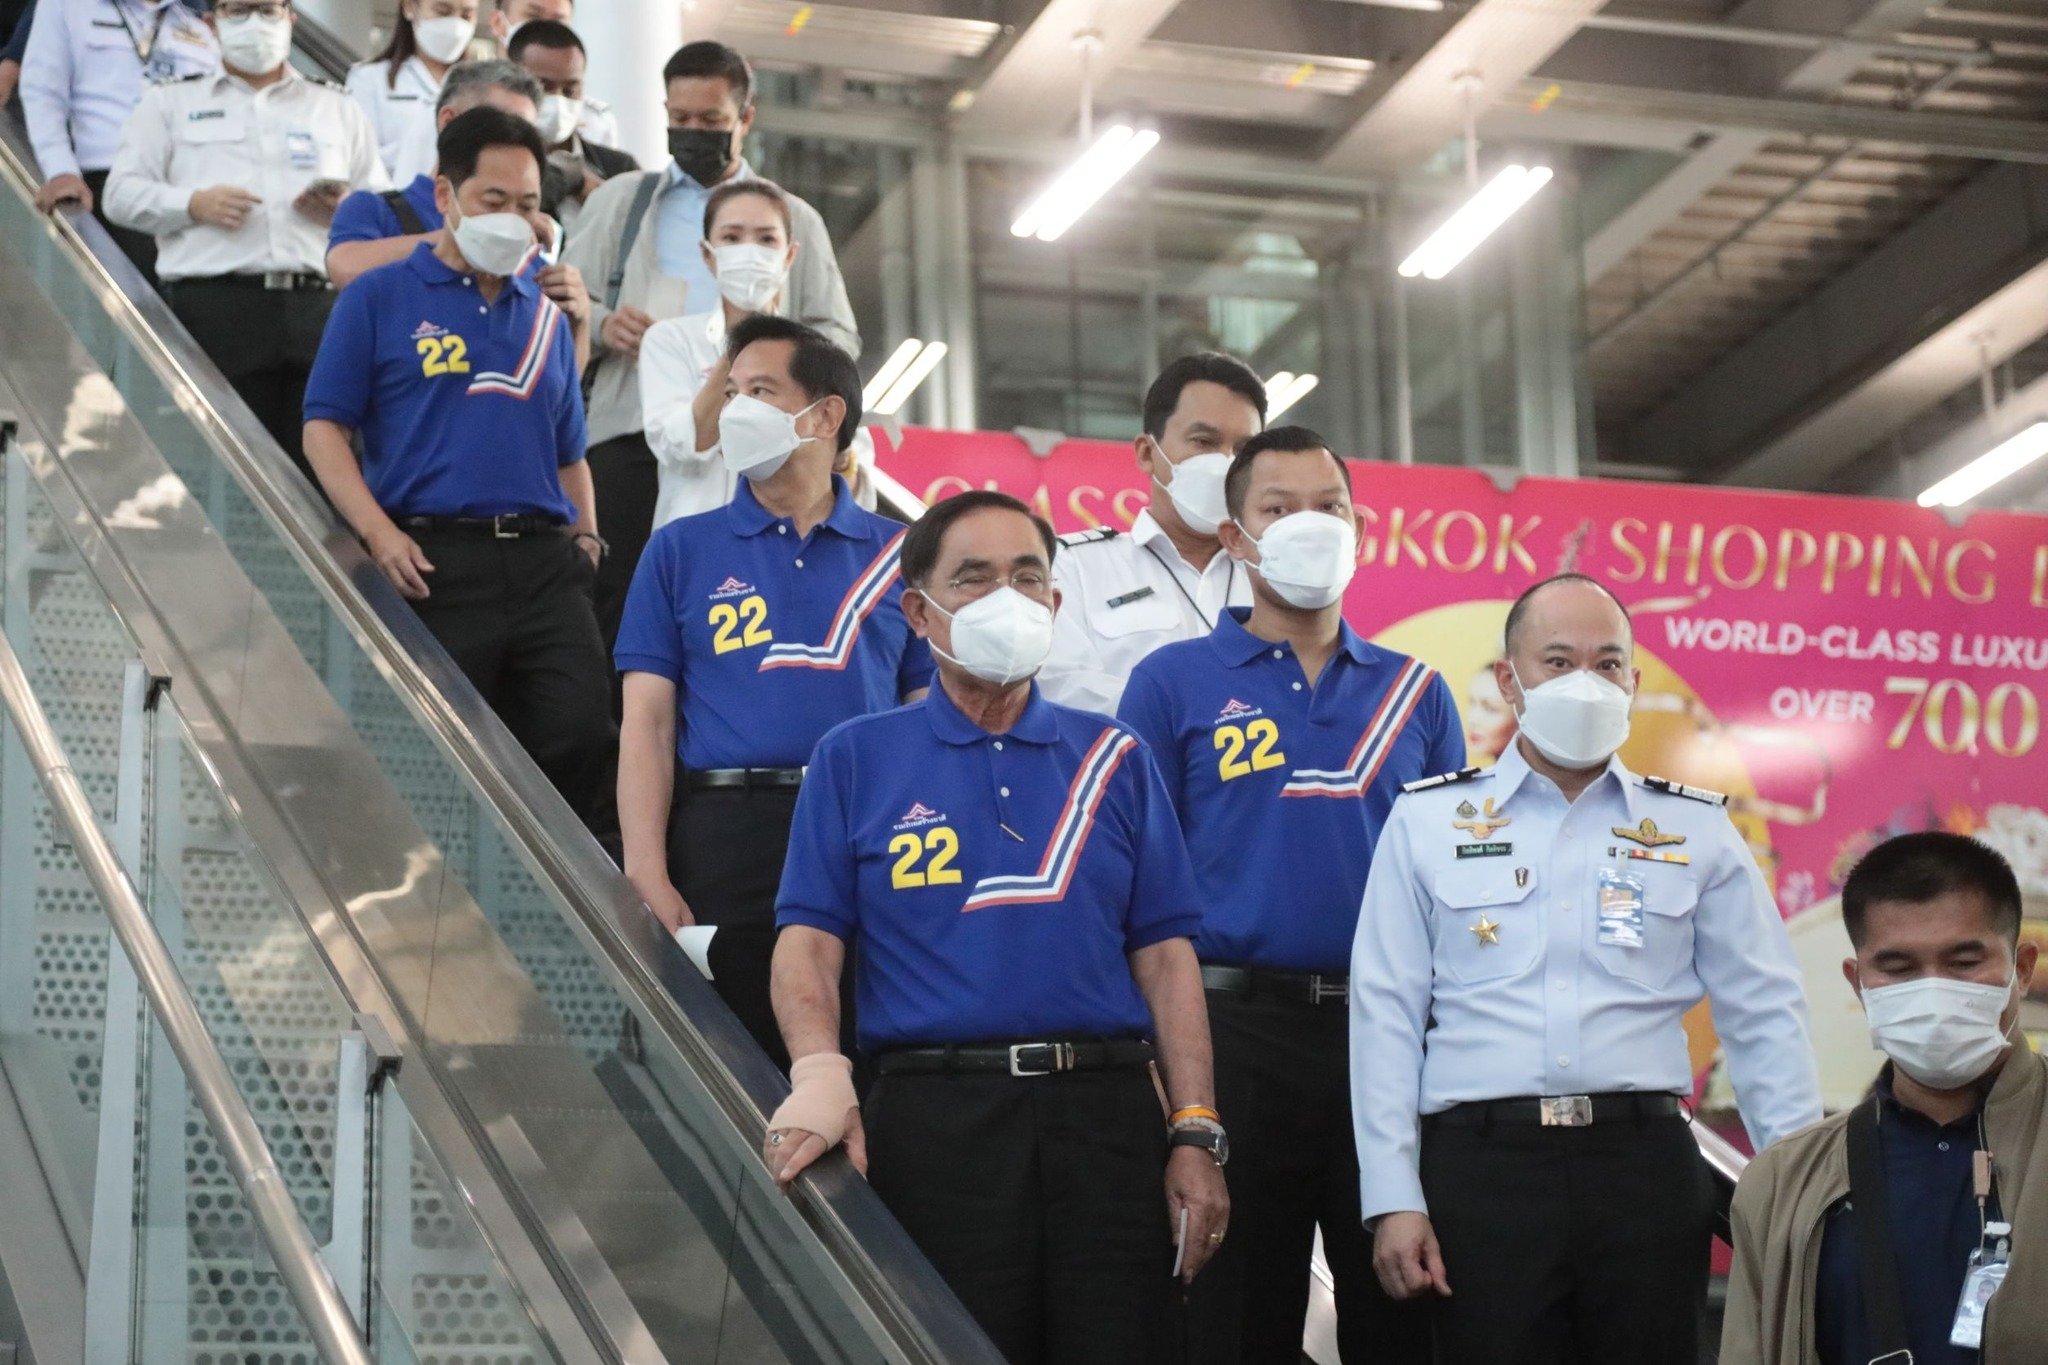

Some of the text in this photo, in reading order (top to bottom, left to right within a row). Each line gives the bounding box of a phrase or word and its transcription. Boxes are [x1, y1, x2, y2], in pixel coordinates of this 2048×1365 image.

[417, 335, 471, 377] 22
[1608, 517, 1997, 605] SHOPPING
[708, 595, 773, 655] 22
[1664, 616, 1941, 664] WORLD-CLASS
[1770, 677, 2041, 758] OVER 700
[1214, 718, 1286, 782] 22
[888, 826, 963, 890] 22
